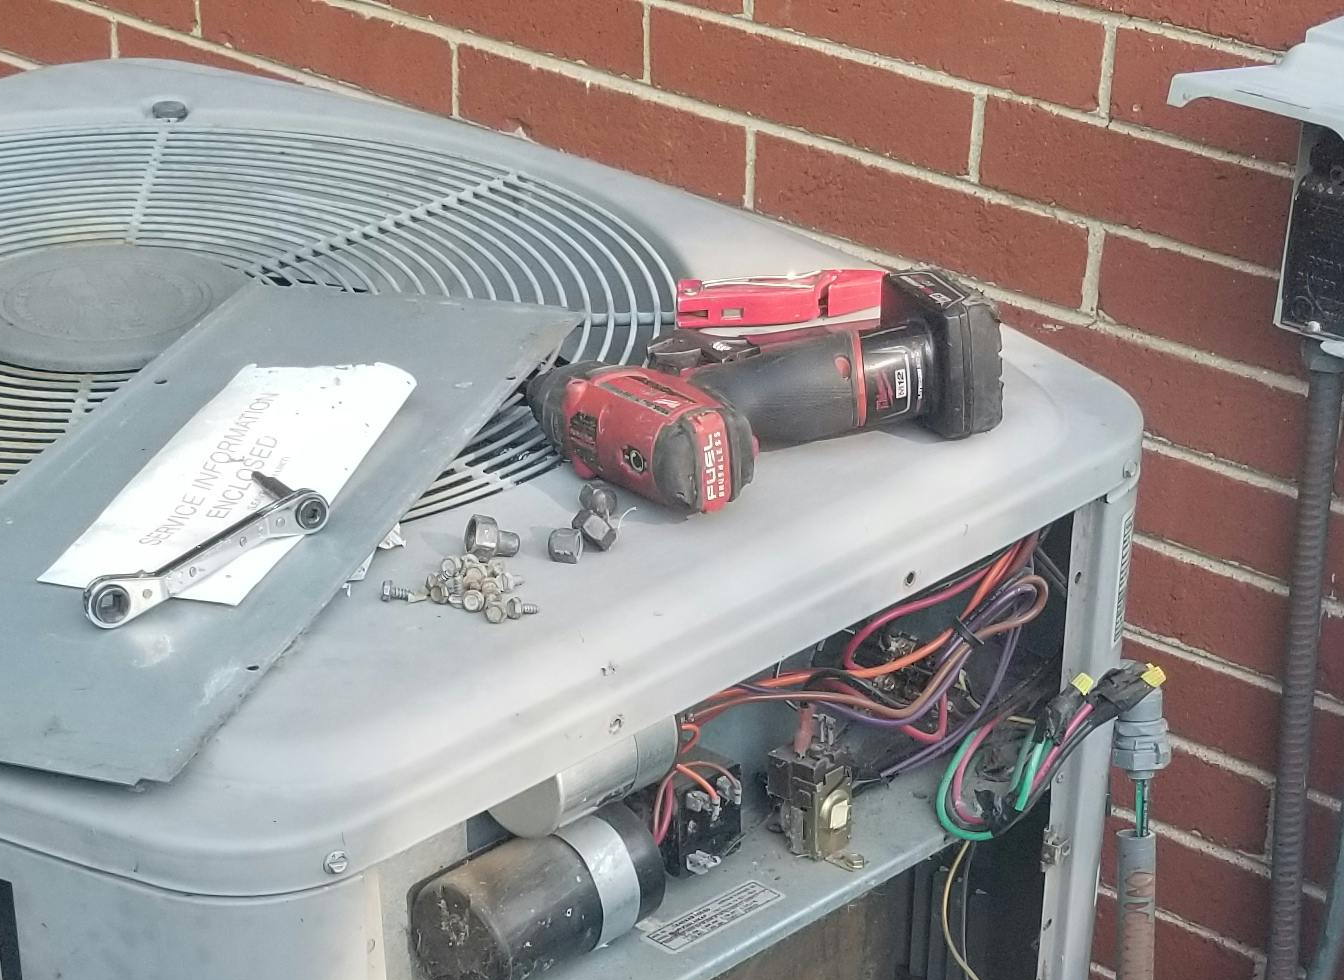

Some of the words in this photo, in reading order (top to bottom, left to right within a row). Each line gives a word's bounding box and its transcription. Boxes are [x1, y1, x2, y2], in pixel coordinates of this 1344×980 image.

[138, 493, 206, 546] SERVICE
[191, 392, 281, 491] INFORMATION
[205, 434, 278, 519] ENCLOSED
[703, 433, 717, 501] FUEL
[714, 431, 725, 498] BRUSHLESS
